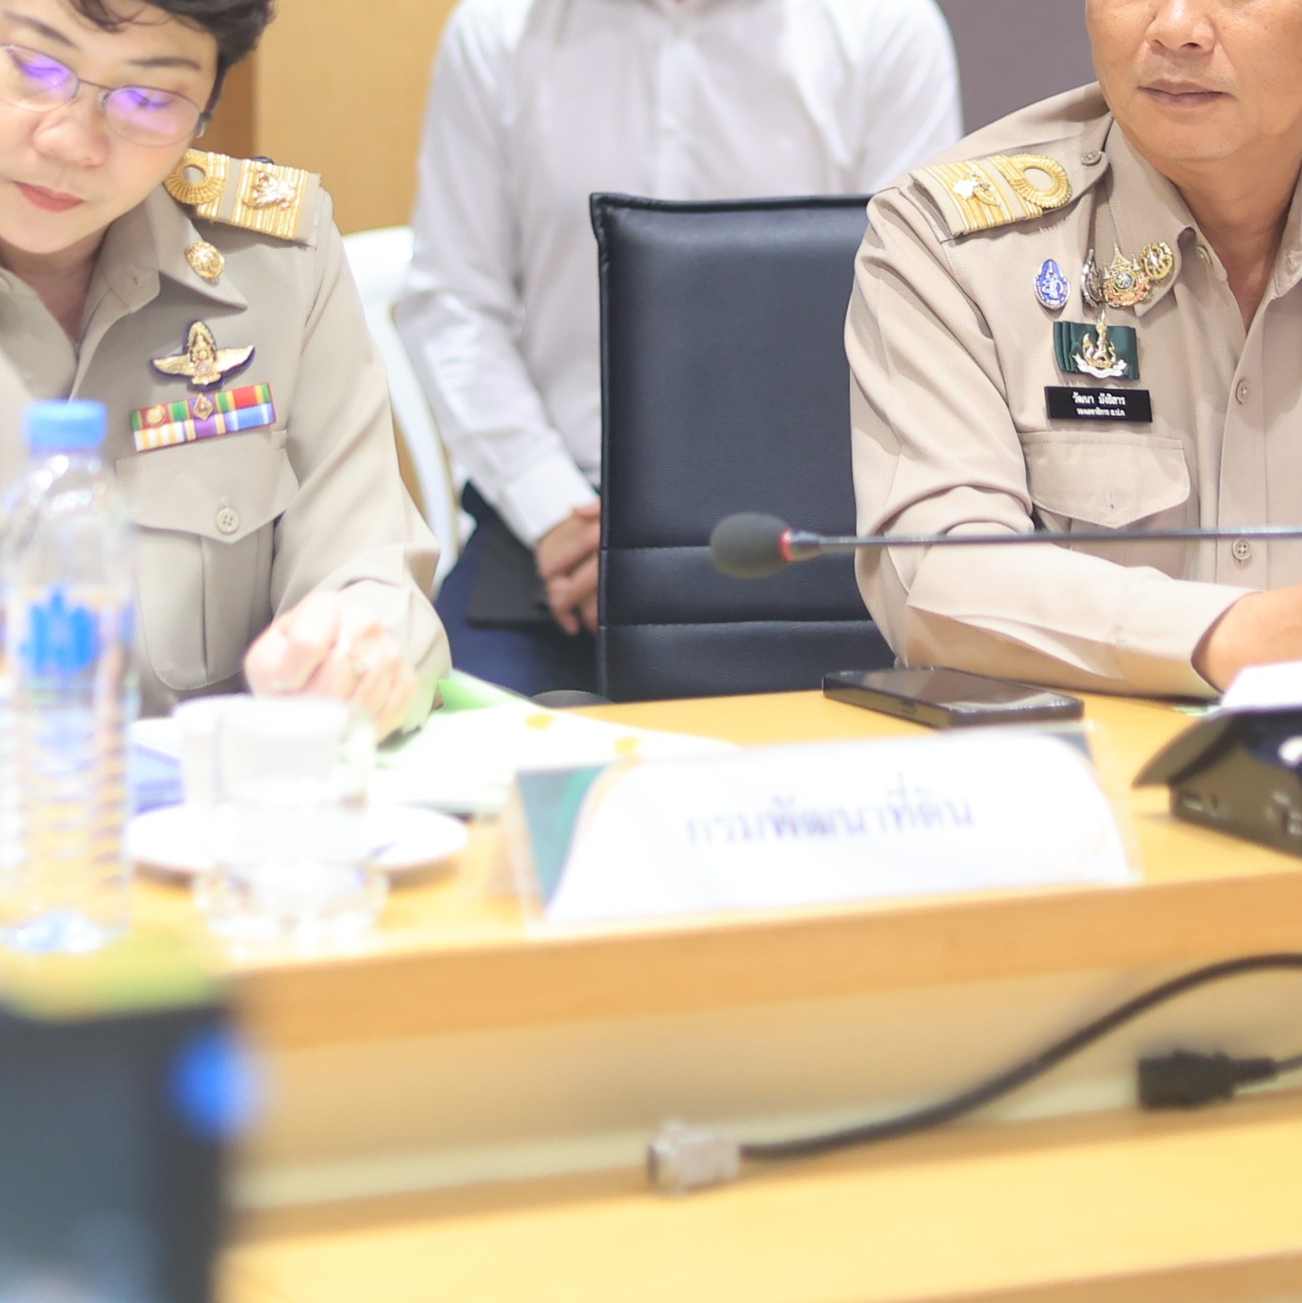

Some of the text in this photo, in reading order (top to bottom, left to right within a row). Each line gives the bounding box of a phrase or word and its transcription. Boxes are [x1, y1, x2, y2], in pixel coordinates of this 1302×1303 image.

[685, 769, 976, 846] กรมพัฒนาที่ดิน
